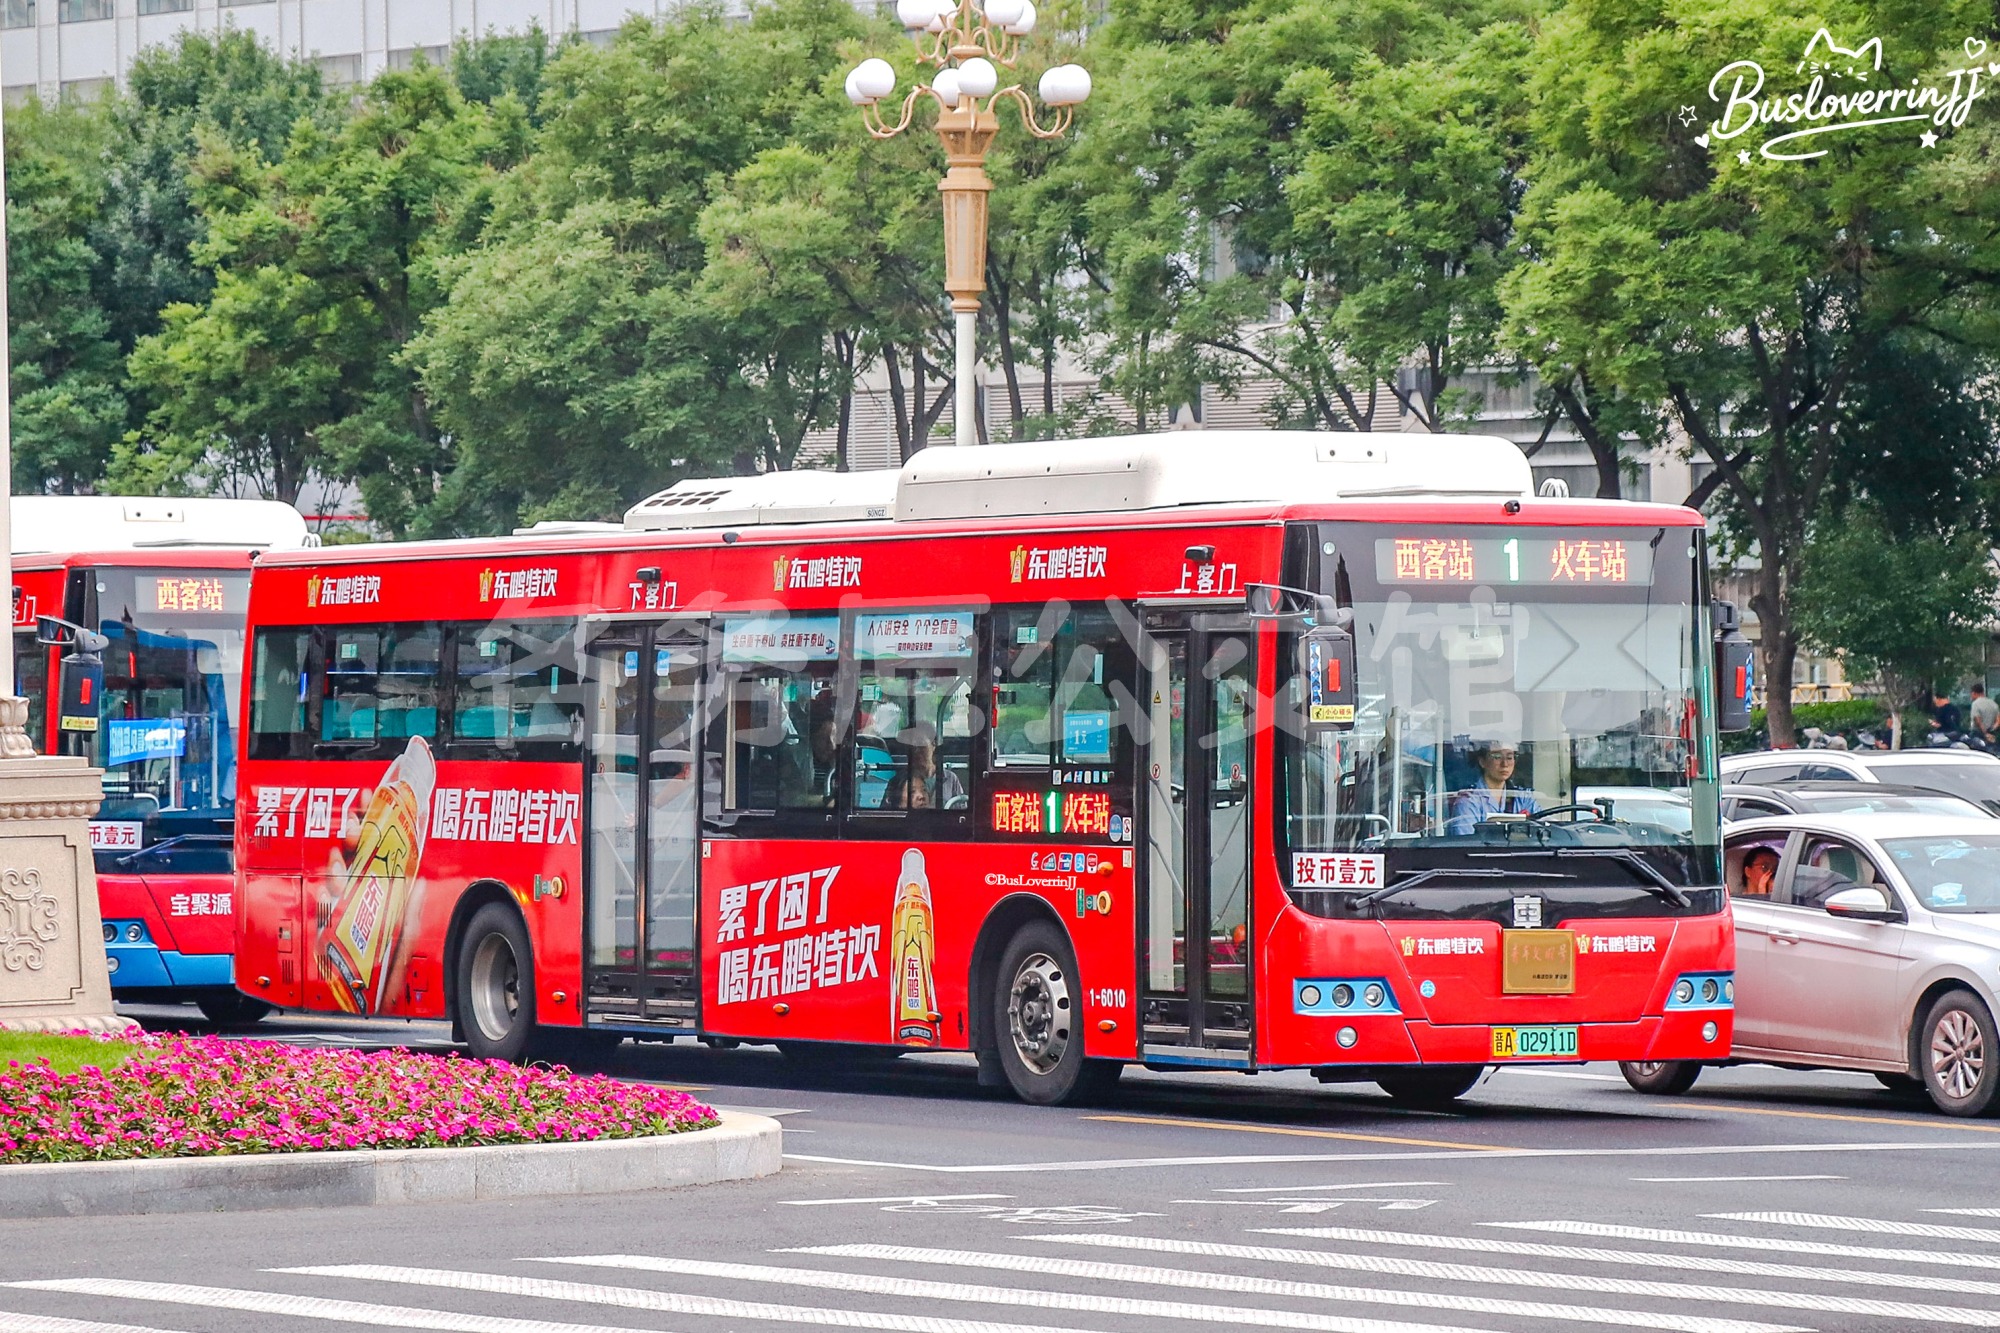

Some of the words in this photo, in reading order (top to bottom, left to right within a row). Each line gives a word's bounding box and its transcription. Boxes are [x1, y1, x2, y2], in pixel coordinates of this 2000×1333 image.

[789, 556, 862, 589] 东鹏特饮
[1028, 545, 1107, 580] 东鹏特饮
[1395, 538, 1473, 580] 西客站
[1503, 538, 1520, 582] 1
[1551, 540, 1626, 582] 火车站
[320, 575, 381, 605] 东鹏特饮
[493, 568, 558, 599] 东鹏特饮
[1174, 562, 1237, 594] 上客门
[156, 578, 224, 611] 西客站
[629, 581, 678, 611] 下客门
[780, 632, 825, 648] 责任重于泰山
[254, 786, 360, 838] 累了困了
[431, 787, 580, 845] 喝东鹏特饮
[994, 792, 1041, 833] 西客站
[1046, 791, 1057, 834] 1
[1063, 793, 1109, 834] 火车站
[1297, 857, 1377, 886] 投币壹元
[170, 893, 233, 917] 宝聚源
[717, 865, 841, 943] 累了困了
[1417, 937, 1484, 955] 东鹏特饮
[1592, 935, 1656, 953] 东鹏特饮
[718, 923, 881, 1006] 喝东鹏特饮
[1089, 988, 1126, 1008] 1-6010
[1520, 1031, 1576, 1053] 02911D
